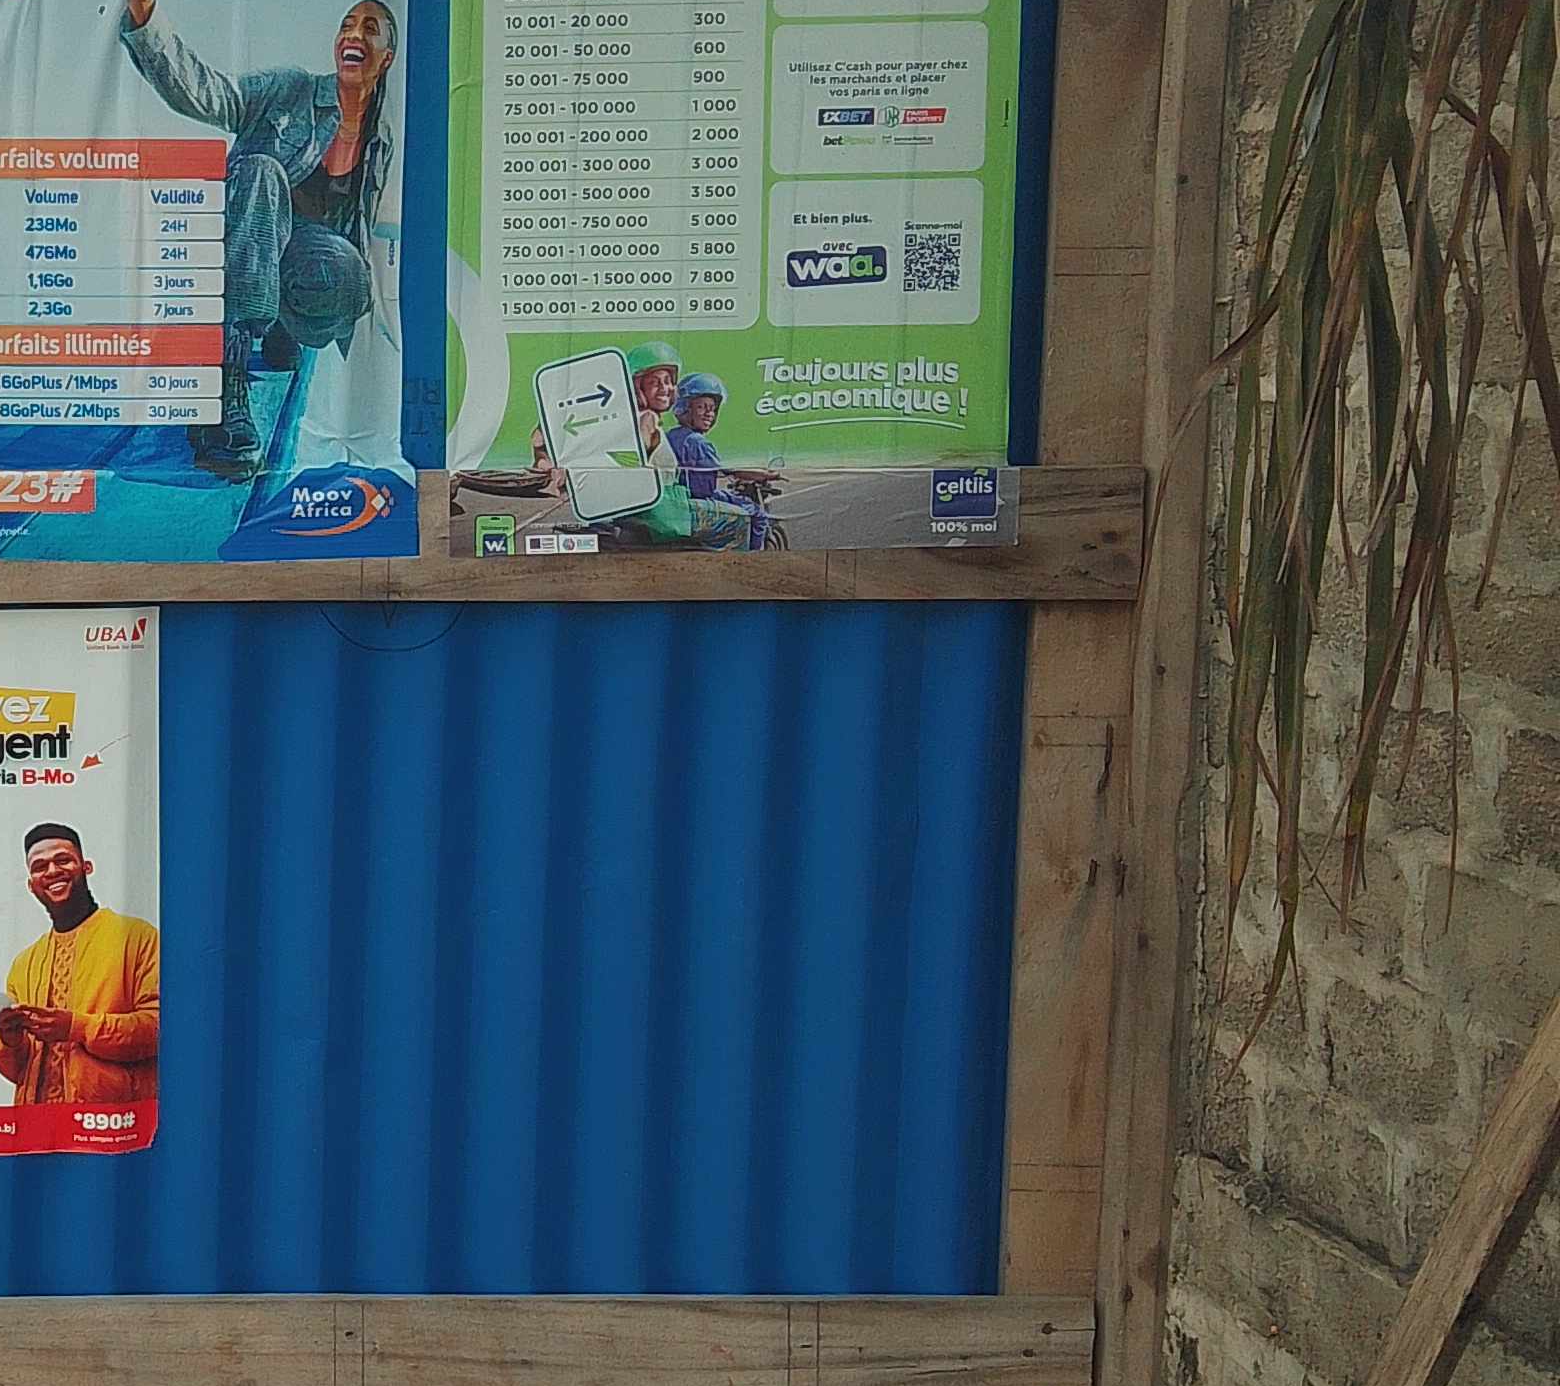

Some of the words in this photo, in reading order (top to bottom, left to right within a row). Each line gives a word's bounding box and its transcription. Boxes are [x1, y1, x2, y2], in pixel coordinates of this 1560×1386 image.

[693, 12, 726, 25] 300
[693, 42, 726, 54] 600
[789, 62, 831, 73] Utilisez
[835, 62, 872, 72] C'cash
[875, 63, 903, 73] pour
[905, 62, 938, 73] payer
[940, 60, 968, 70] chez
[693, 70, 725, 83] 900
[59, 147, 140, 170] volume
[25, 188, 79, 204] Volume
[151, 189, 205, 205] Validité
[25, 217, 78, 233] 238Mo
[161, 219, 188, 233] 24H
[793, 214, 807, 224] Et
[811, 213, 838, 224] bien
[25, 245, 78, 261] 476Mo
[161, 247, 188, 261] 24H
[823, 241, 853, 252] avec
[27, 273, 74, 290] 1,16Go
[153, 276, 163, 289] 3
[164, 276, 195, 290] jours
[28, 301, 73, 319] 2,3Go
[154, 304, 162, 316] 7
[164, 304, 194, 319] jours
[65, 333, 152, 356] illimités
[756, 357, 889, 386] Toujours
[895, 356, 959, 386] plus
[148, 376, 165, 389] 30
[167, 376, 199, 391] jours
[755, 382, 951, 417] économique
[148, 406, 165, 419] 30
[167, 406, 199, 420] jours
[935, 477, 994, 494] celtiis
[291, 487, 353, 503] Moov
[291, 502, 353, 518] Africa
[930, 521, 968, 533] 100%
[971, 520, 998, 532] moi
[85, 626, 128, 643] UBA
[21, 769, 75, 785] B-Mo
